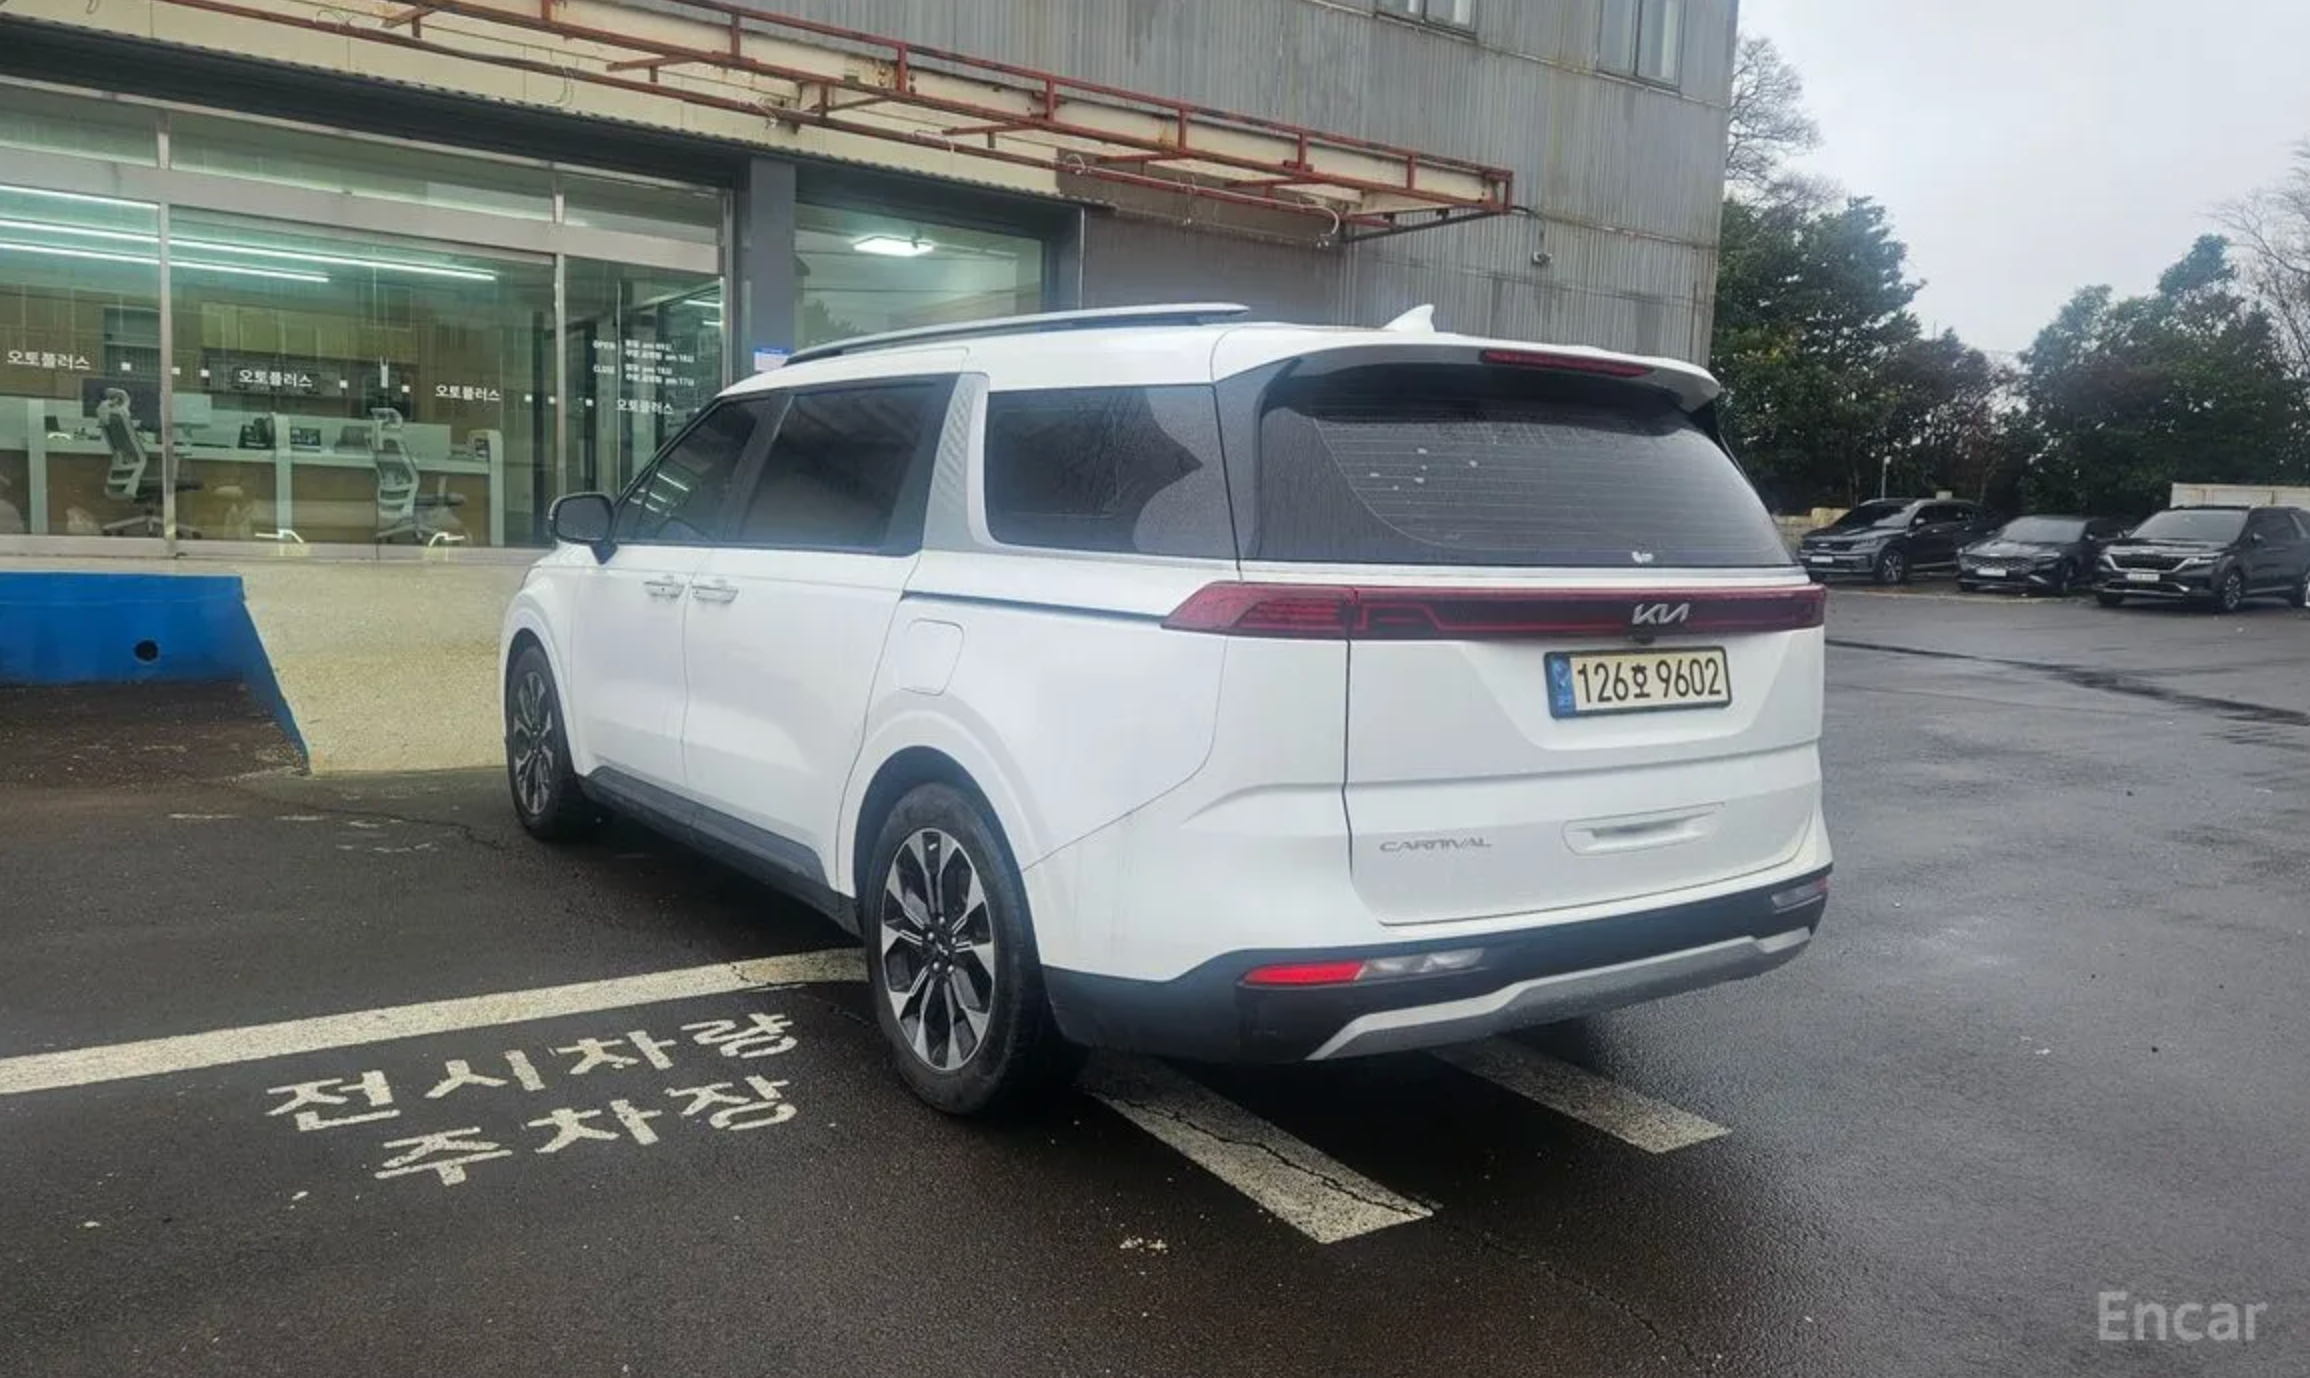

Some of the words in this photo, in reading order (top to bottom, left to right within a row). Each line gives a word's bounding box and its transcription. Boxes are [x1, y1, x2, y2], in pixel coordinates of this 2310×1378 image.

[7, 350, 91, 370] 오토플러스
[239, 369, 313, 388] 오토플러스
[435, 384, 501, 402] 오토플러스
[616, 398, 674, 415] 오토플러스
[1632, 603, 1691, 624] KIA
[1379, 838, 1492, 853] CARNIVAL
[267, 1012, 797, 1131] 전시차량
[374, 1074, 797, 1186] 주차장
